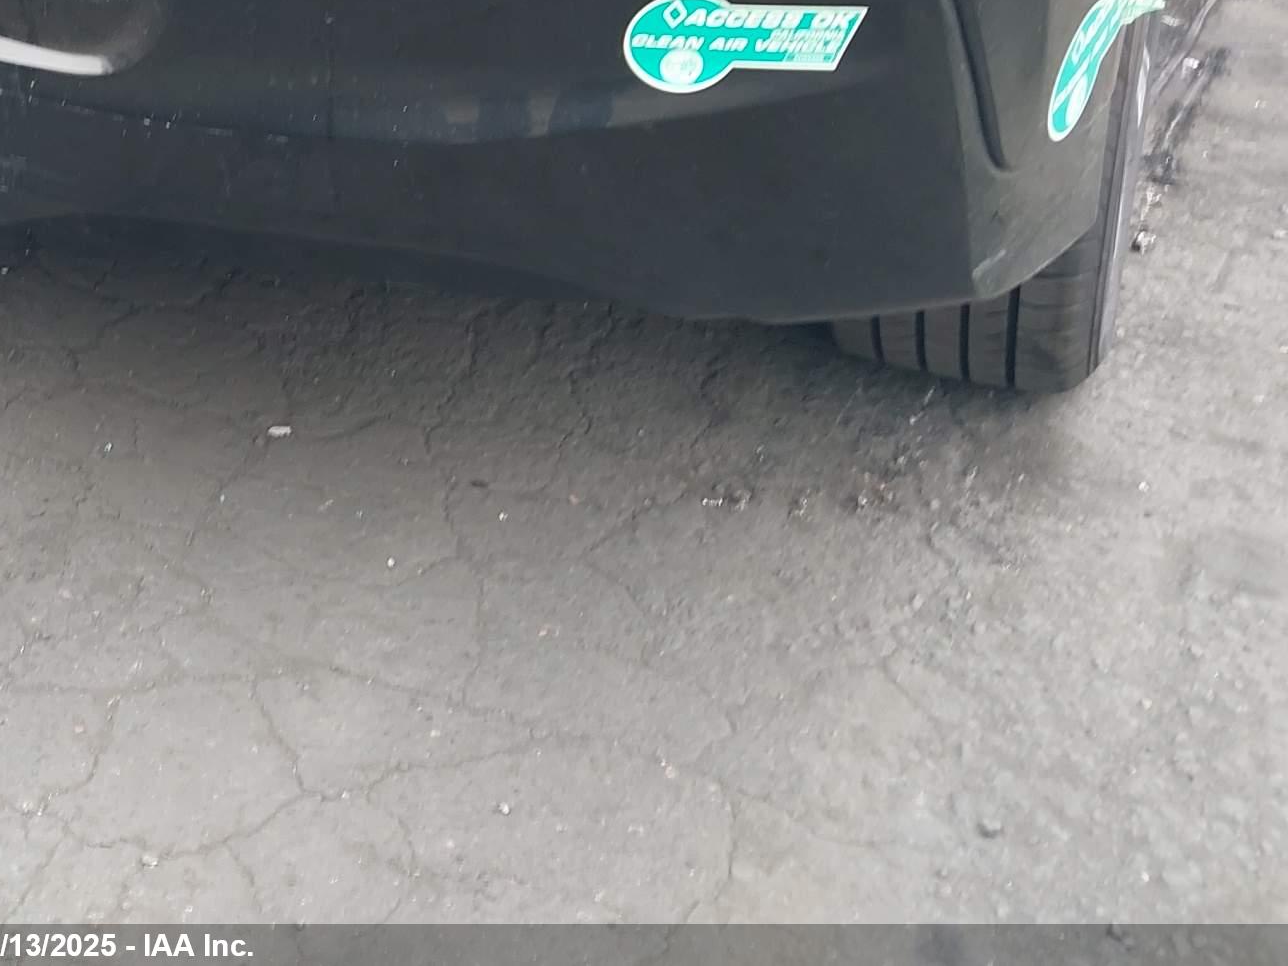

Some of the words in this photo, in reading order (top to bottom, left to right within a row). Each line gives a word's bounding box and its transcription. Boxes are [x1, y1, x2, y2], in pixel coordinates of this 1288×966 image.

[684, 8, 801, 30] ACCESS
[811, 9, 855, 30] OK
[631, 33, 704, 51] CLEAN
[708, 35, 749, 52] AIR
